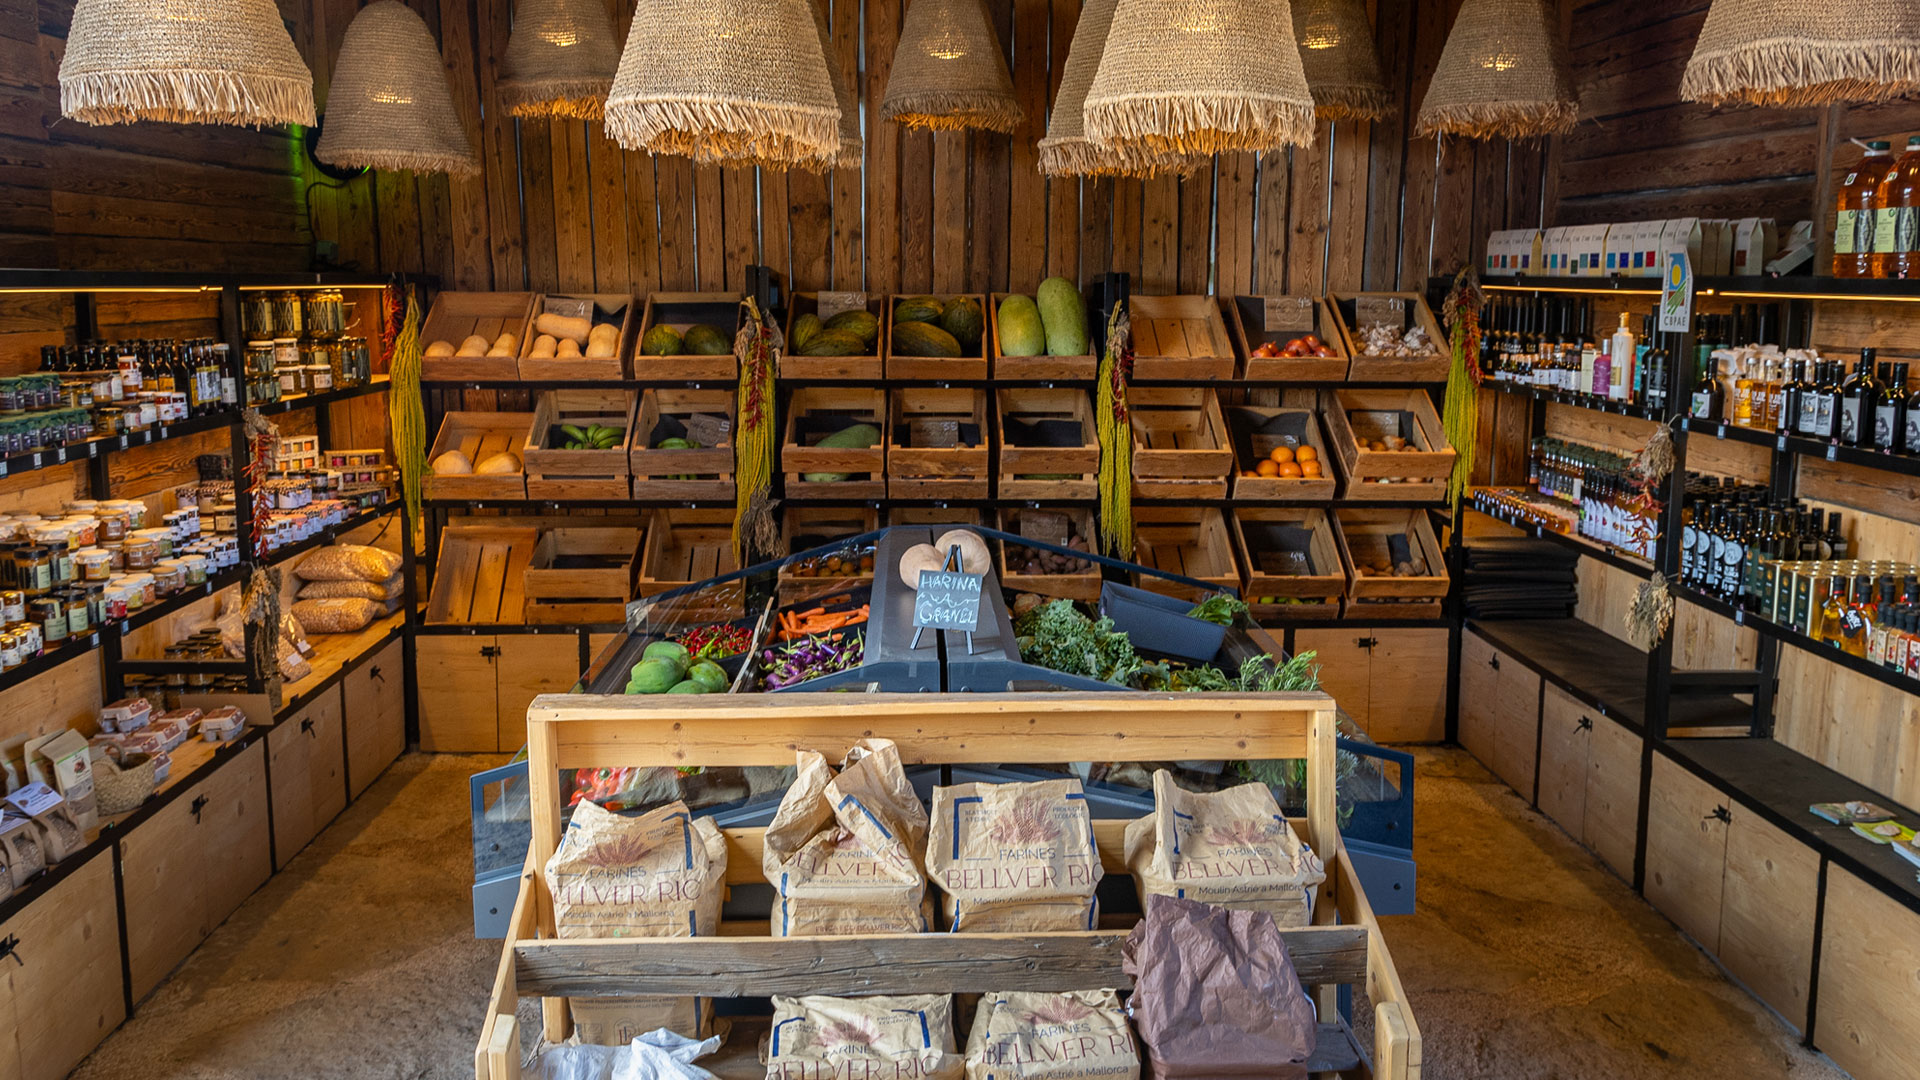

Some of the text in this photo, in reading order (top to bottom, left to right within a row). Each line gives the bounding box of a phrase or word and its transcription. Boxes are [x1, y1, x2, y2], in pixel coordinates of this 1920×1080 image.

[921, 574, 980, 592] HARINA
[919, 602, 977, 624] GRANEL
[1000, 848, 1056, 861] FARINES
[1217, 847, 1273, 858] FARINES
[590, 866, 647, 880] FARINES
[947, 866, 1059, 890] BELLVER
[1172, 859, 1283, 881] BELLVER
[552, 878, 701, 906] ELLVER RIC
[1199, 886, 1231, 895] Moulin
[1269, 883, 1302, 892] Mallorc
[1032, 1023, 1091, 1039] FARINES
[982, 1032, 1134, 1065] BELLVER RI
[895, 1055, 939, 1080] RIC
[1085, 1066, 1129, 1076] Mallorca
